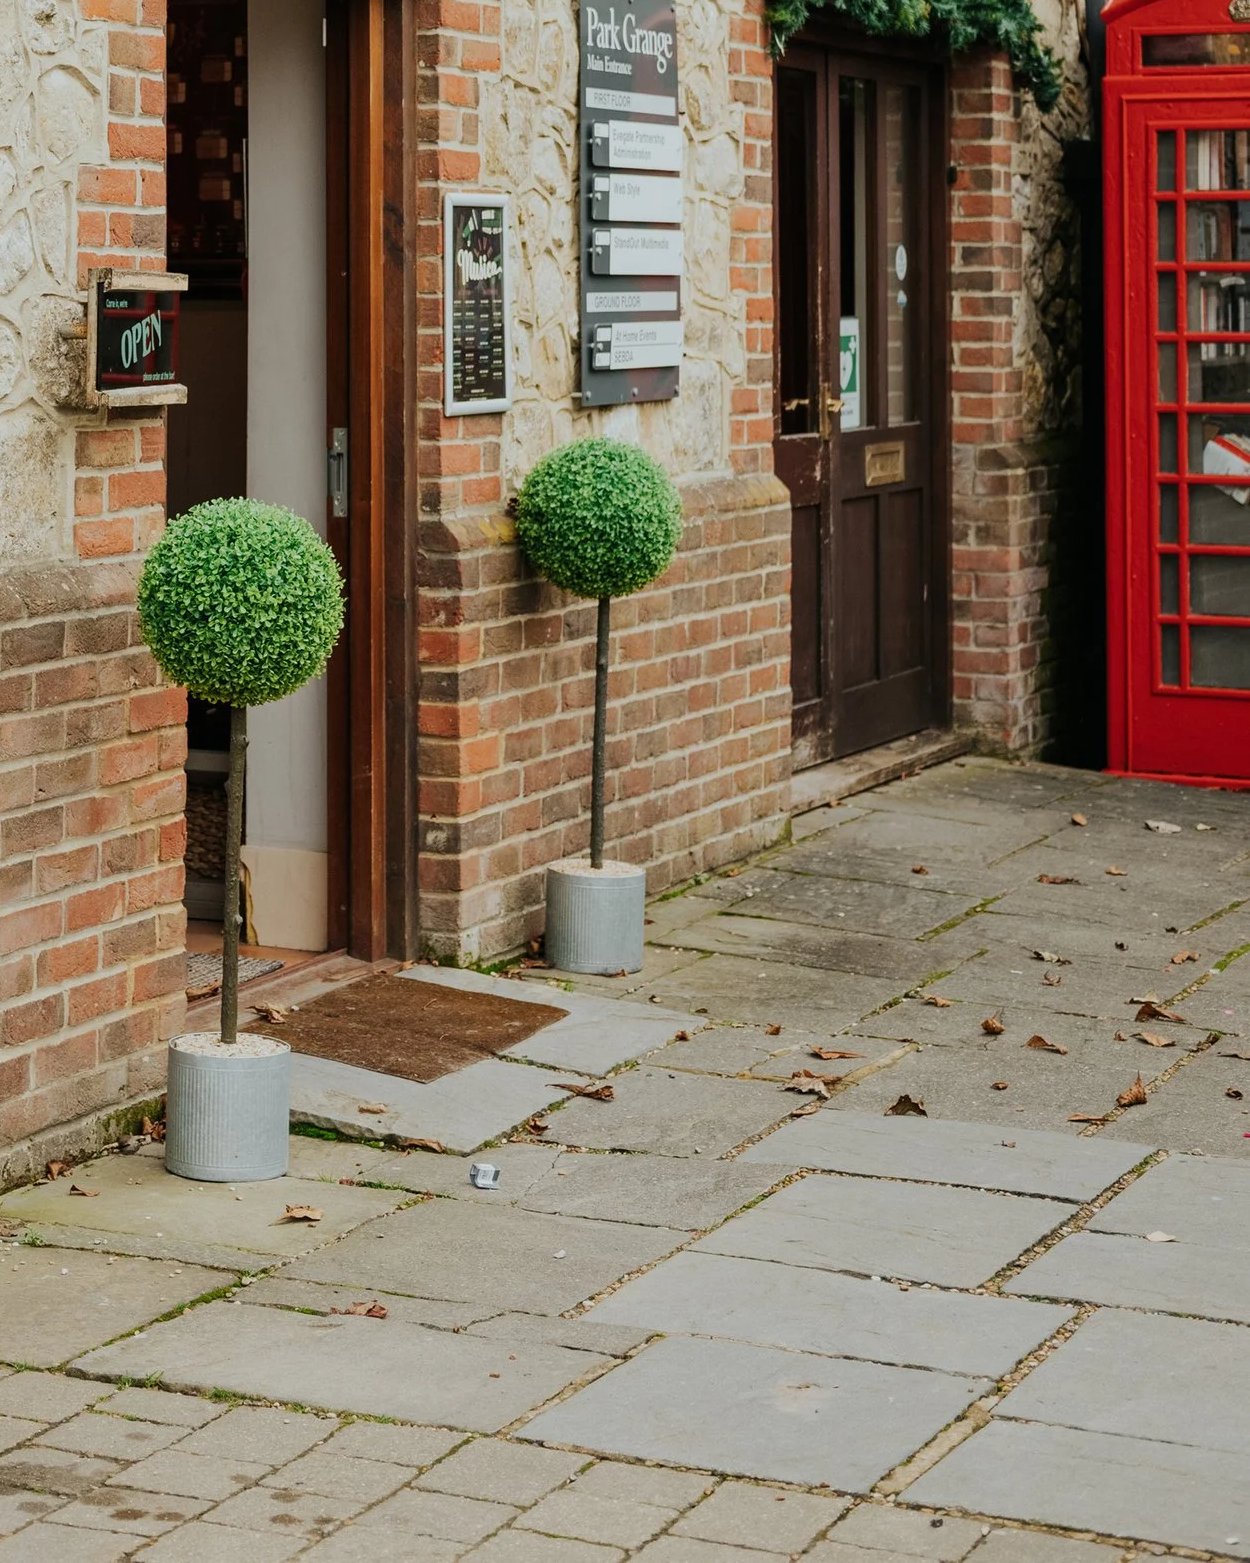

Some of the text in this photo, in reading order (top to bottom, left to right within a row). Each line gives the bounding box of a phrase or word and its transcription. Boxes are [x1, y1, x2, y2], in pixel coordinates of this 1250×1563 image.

[586, 6, 673, 74] Park Grange
[587, 54, 632, 75] Main Entrance
[612, 94, 631, 107] FLOOR
[627, 183, 640, 198] Style
[595, 296, 640, 308] GROUND FLOOR
[121, 310, 161, 368] OPEN
